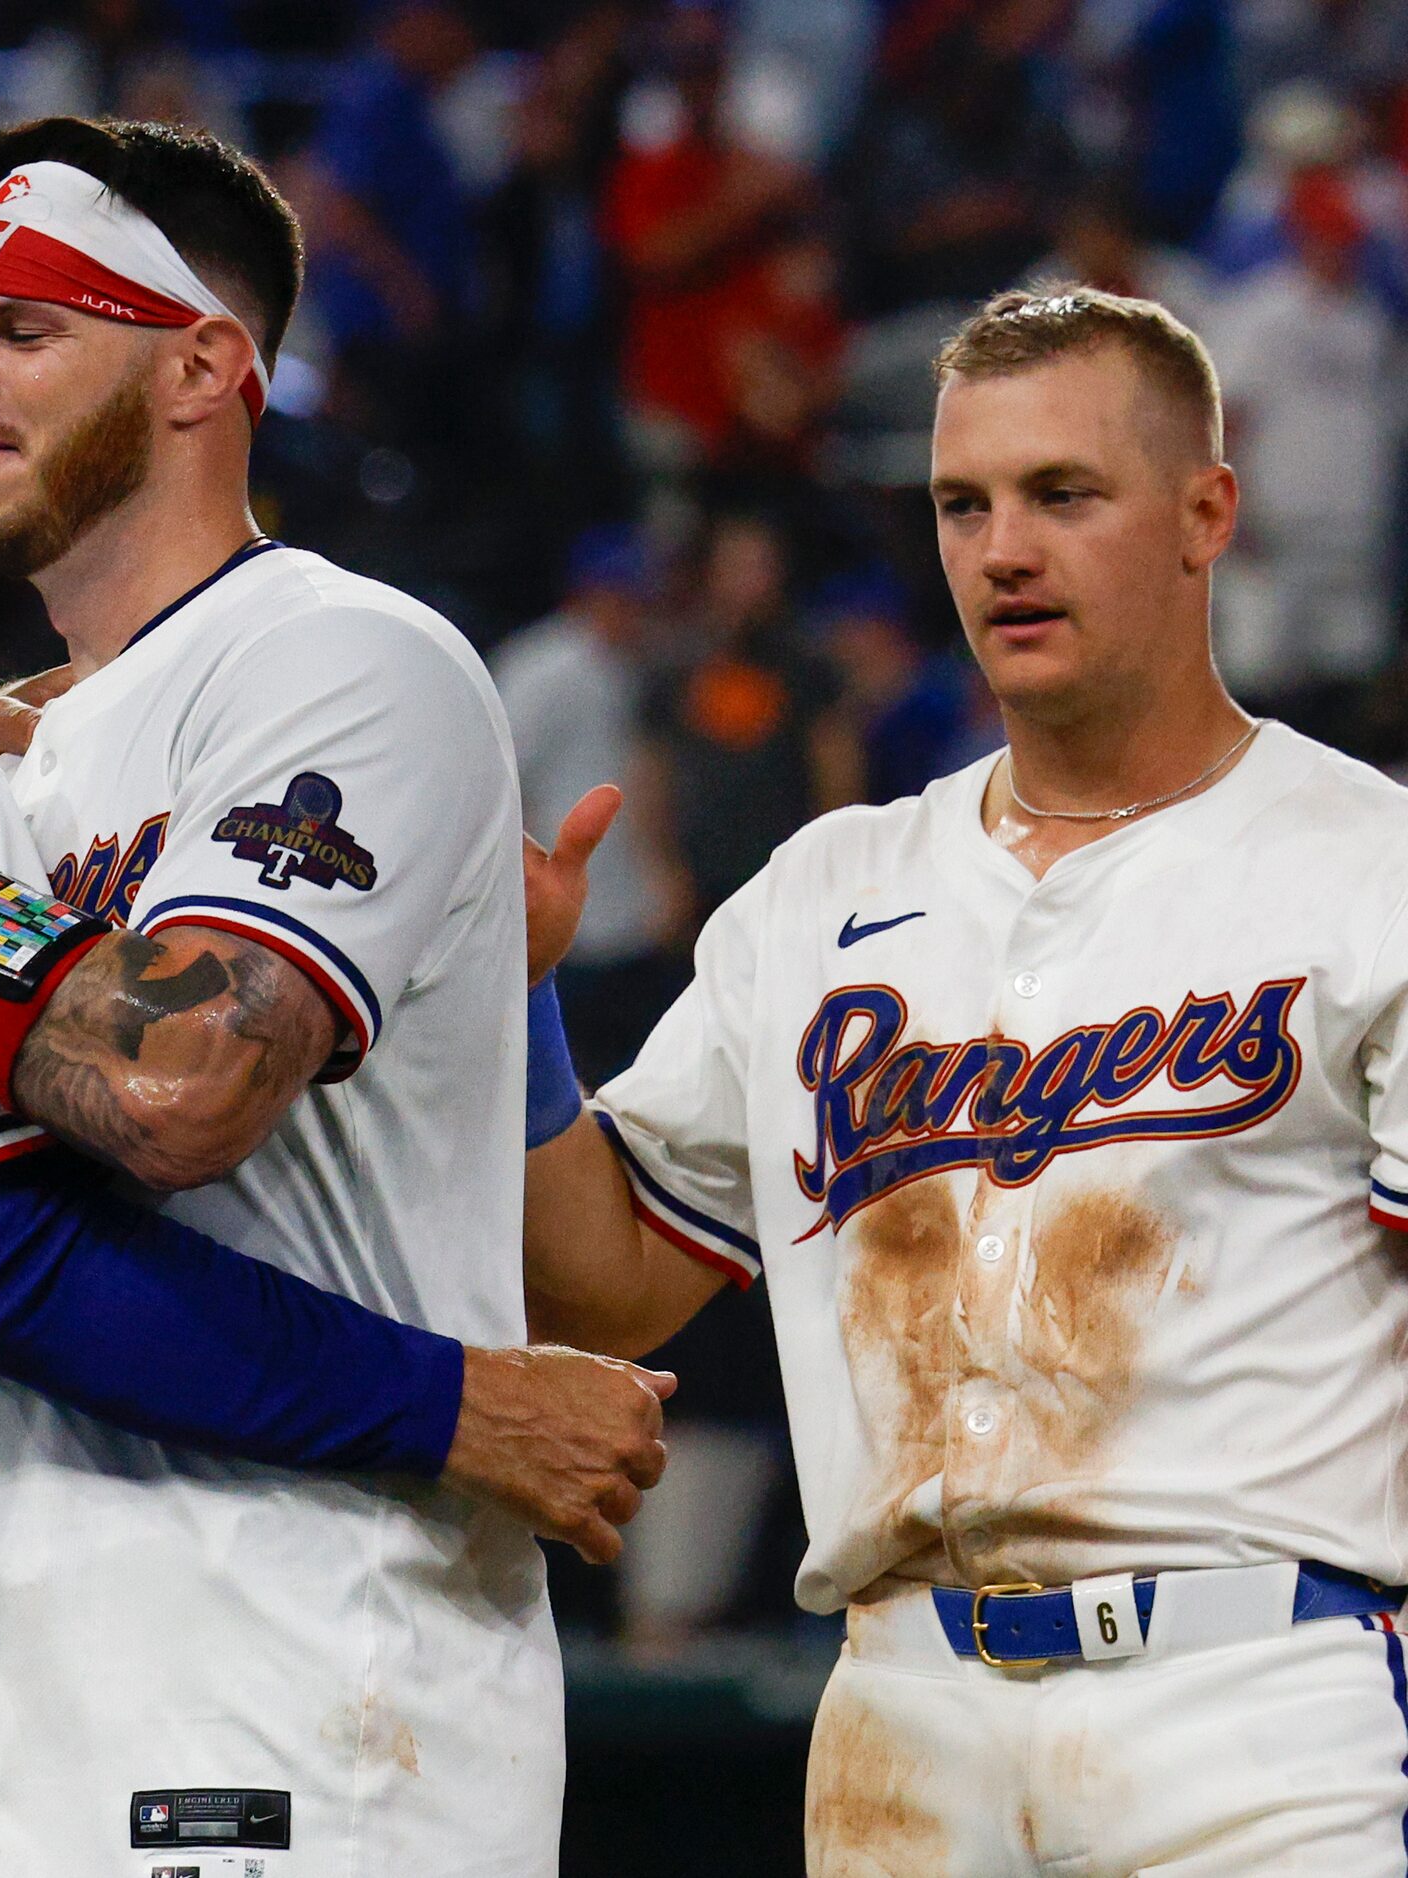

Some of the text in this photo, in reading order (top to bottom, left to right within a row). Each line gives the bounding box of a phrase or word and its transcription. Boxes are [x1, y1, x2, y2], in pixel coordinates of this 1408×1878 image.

[70, 294, 135, 319] JUNK
[217, 819, 371, 886] CHAMPIONS
[266, 843, 306, 882] T
[791, 976, 1307, 1245] Rangers
[1096, 1602, 1118, 1644] 6
